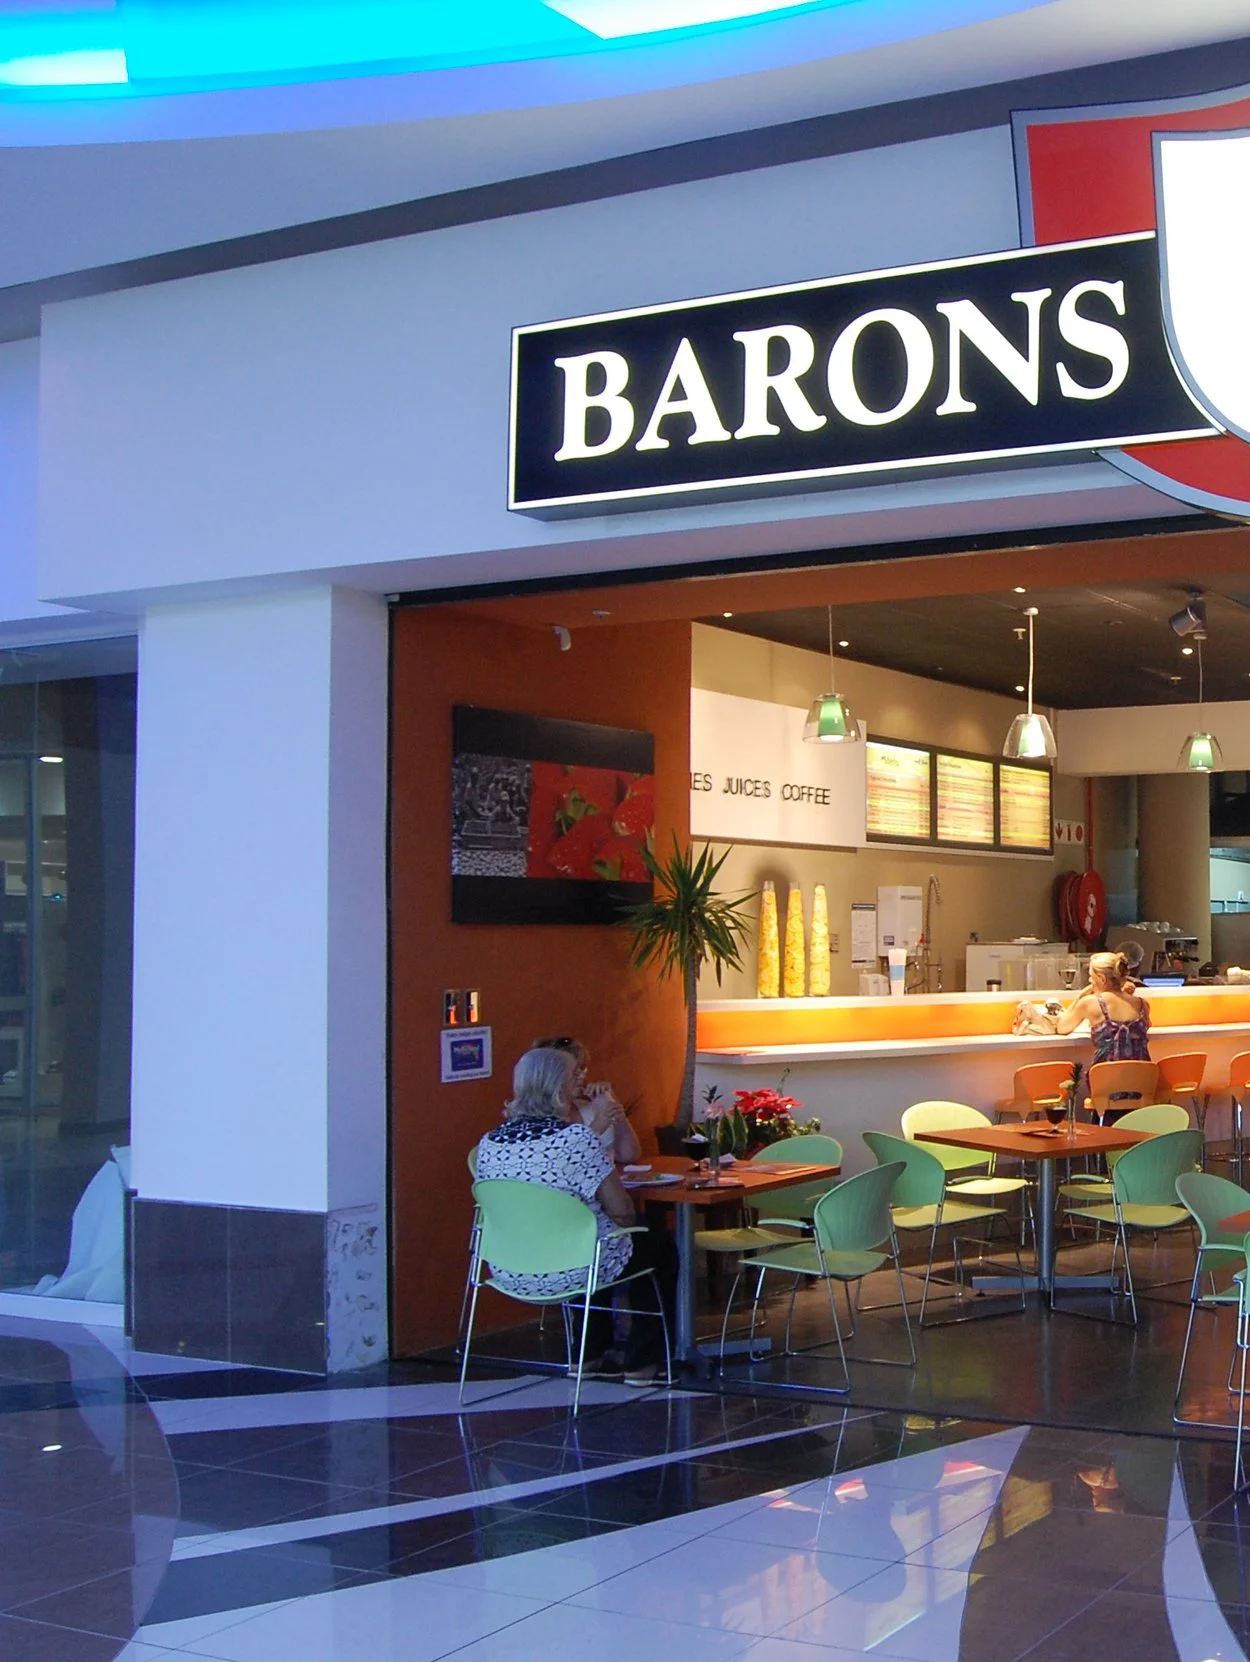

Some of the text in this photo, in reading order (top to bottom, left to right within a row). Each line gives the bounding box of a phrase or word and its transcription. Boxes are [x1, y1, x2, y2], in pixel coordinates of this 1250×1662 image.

[555, 280, 1130, 462] BARONS
[722, 777, 772, 799] JUICES
[781, 783, 831, 806] COFFEE
